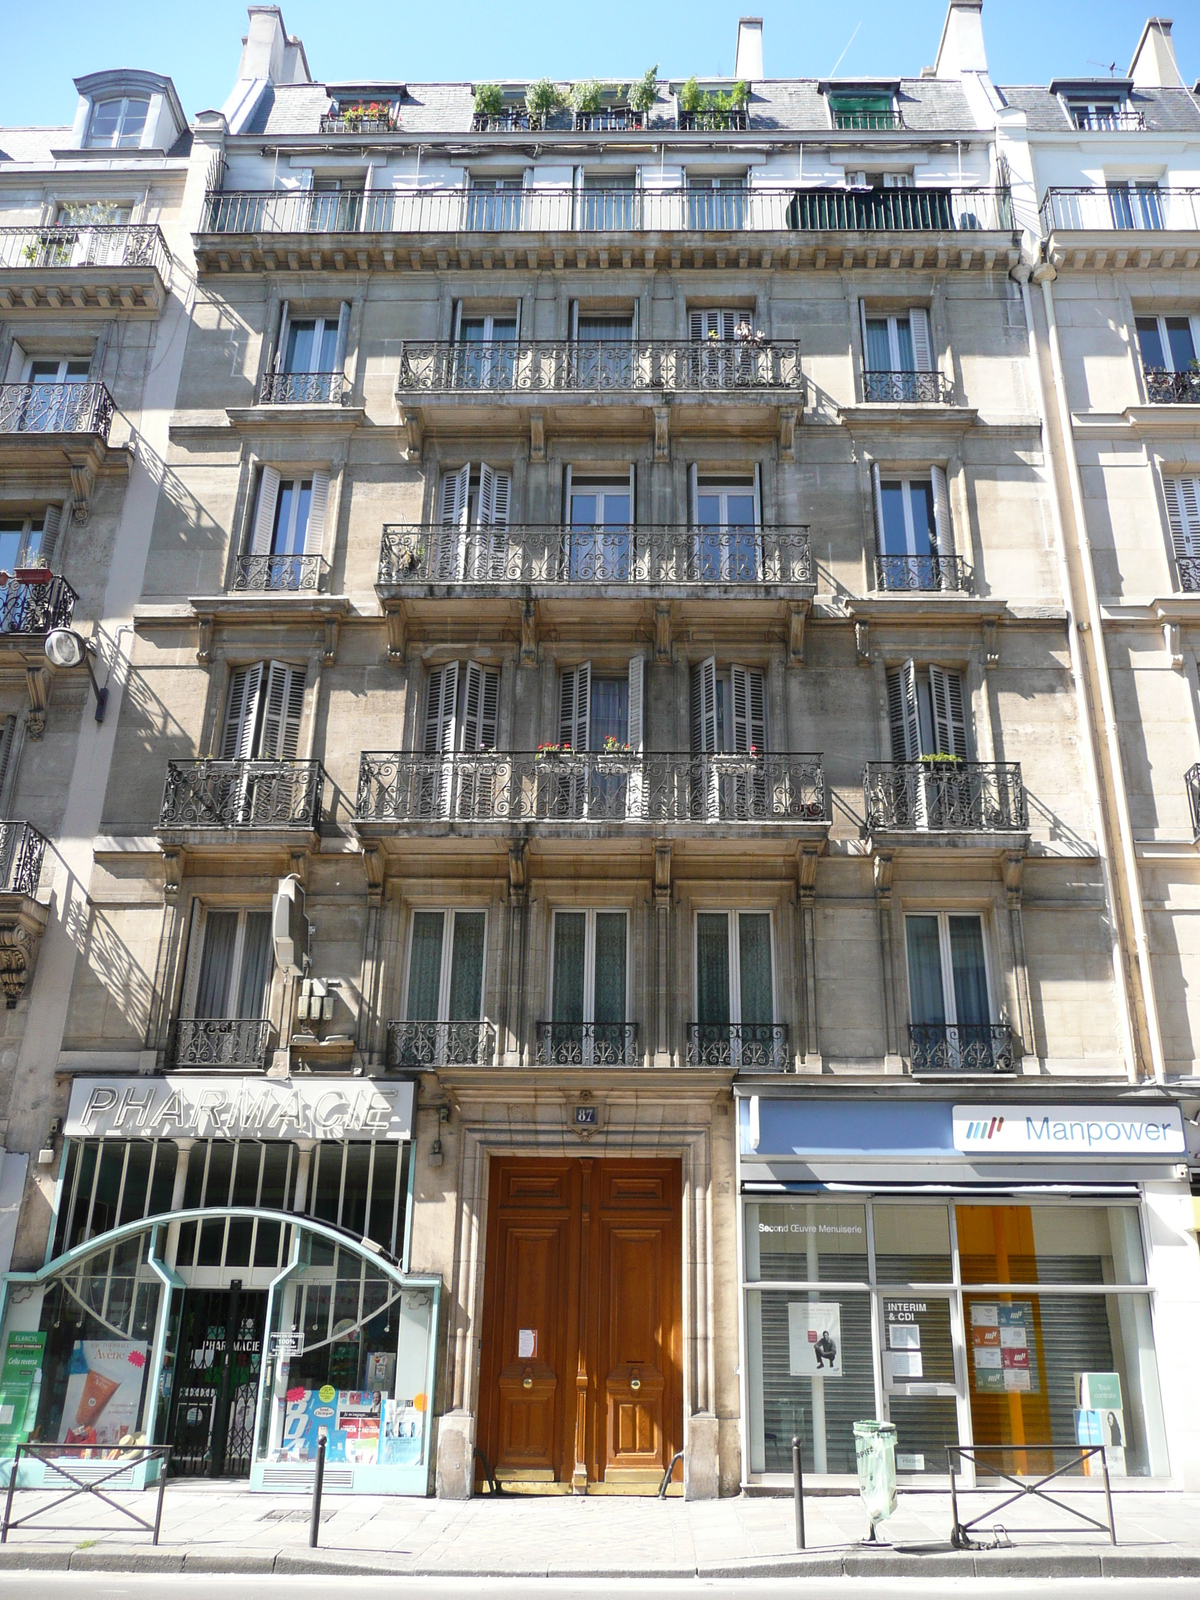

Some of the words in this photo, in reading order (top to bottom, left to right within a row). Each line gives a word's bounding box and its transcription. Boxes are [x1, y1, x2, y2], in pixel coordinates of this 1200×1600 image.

[79, 1086, 399, 1130] PHARMACIE
[577, 1109, 593, 1122] 87
[1025, 1116, 1171, 1147] Manpower
[758, 1223, 789, 1233] Second
[818, 1224, 862, 1234] Menuiserie
[888, 1303, 927, 1312] INTERIM
[889, 1313, 896, 1321] &
[898, 1313, 915, 1321] CDI
[93, 1348, 126, 1360] Avène
